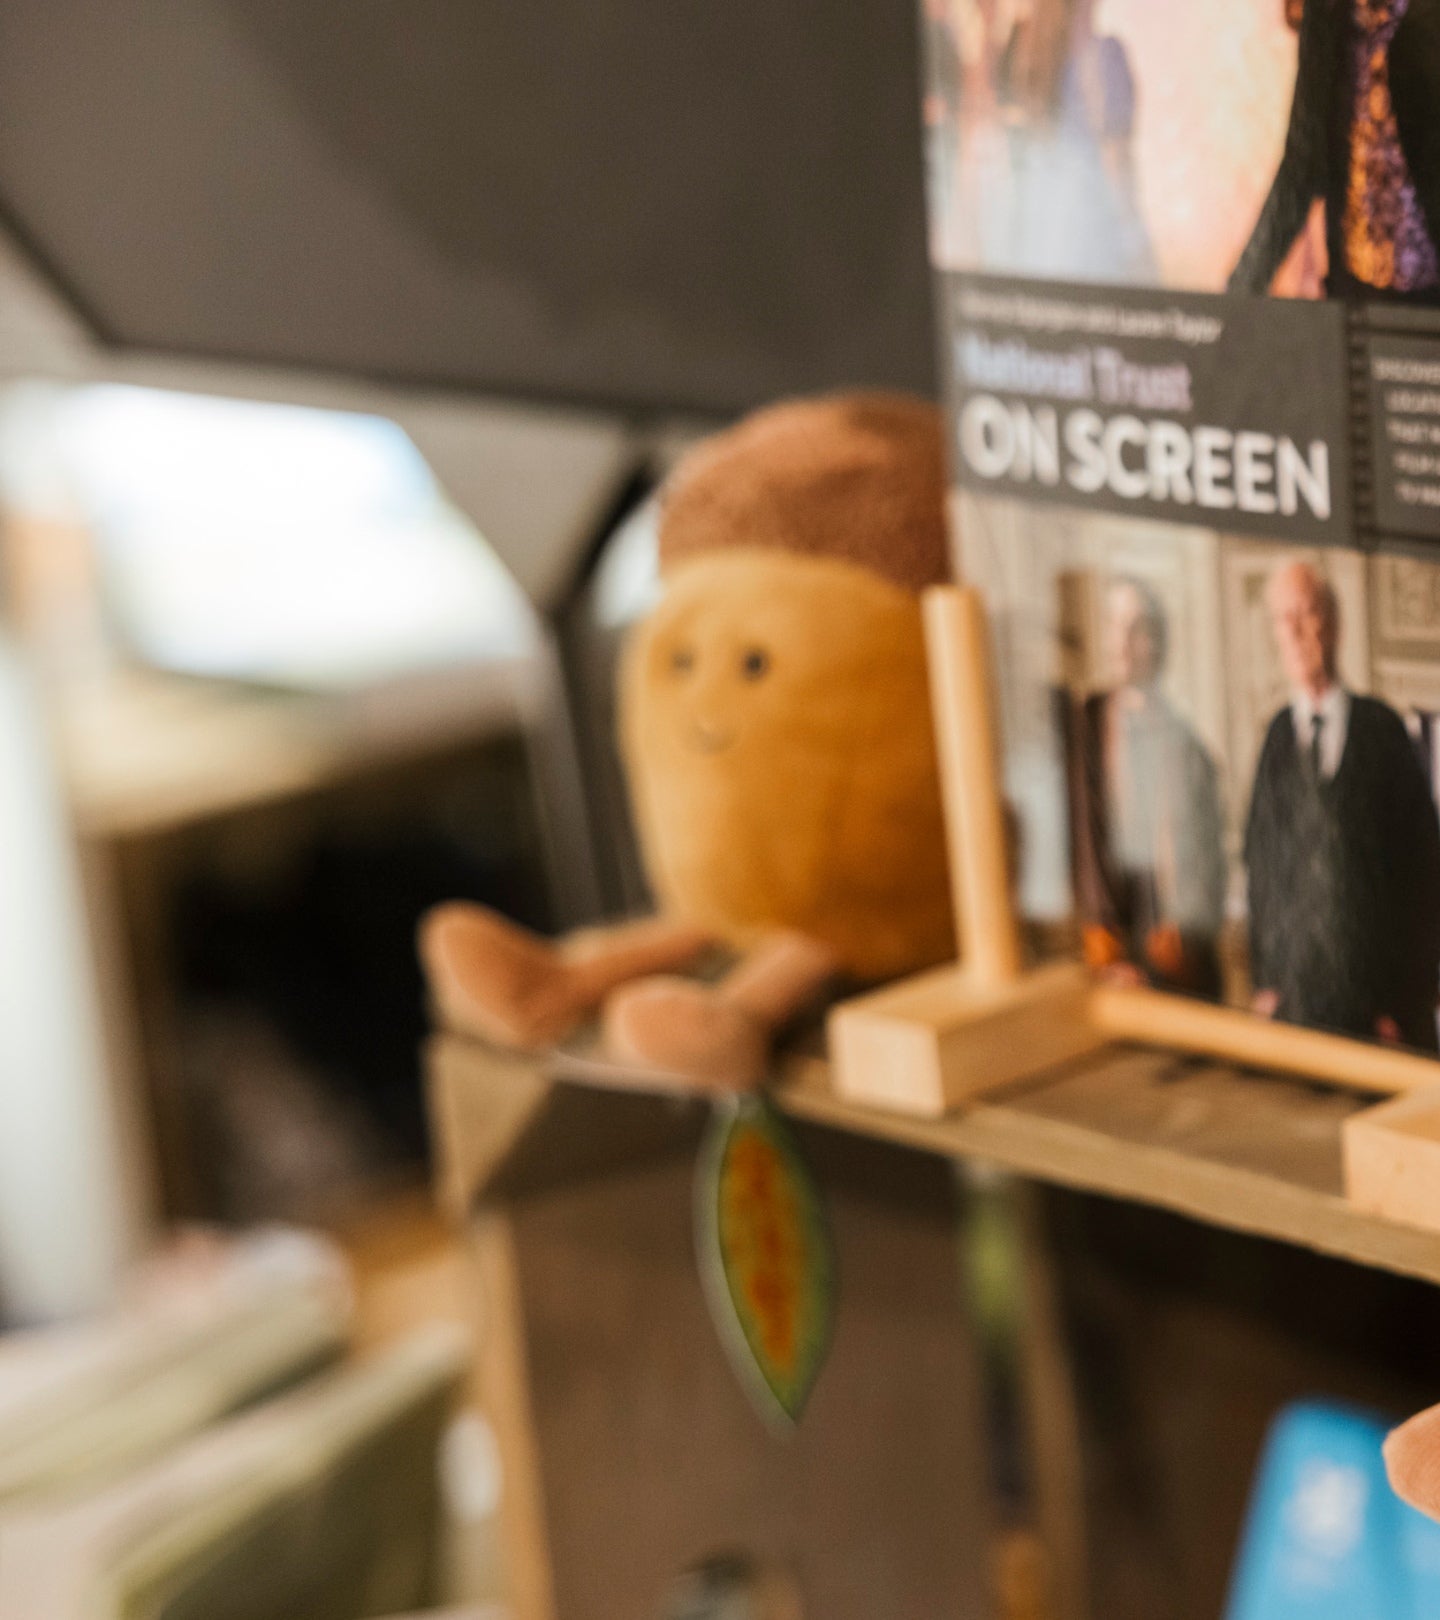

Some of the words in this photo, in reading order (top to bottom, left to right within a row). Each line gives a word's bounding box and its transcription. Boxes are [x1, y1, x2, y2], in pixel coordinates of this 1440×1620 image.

[1094, 346, 1191, 411] Trust
[958, 395, 1059, 487] ON
[1064, 408, 1331, 521] SCREEN
